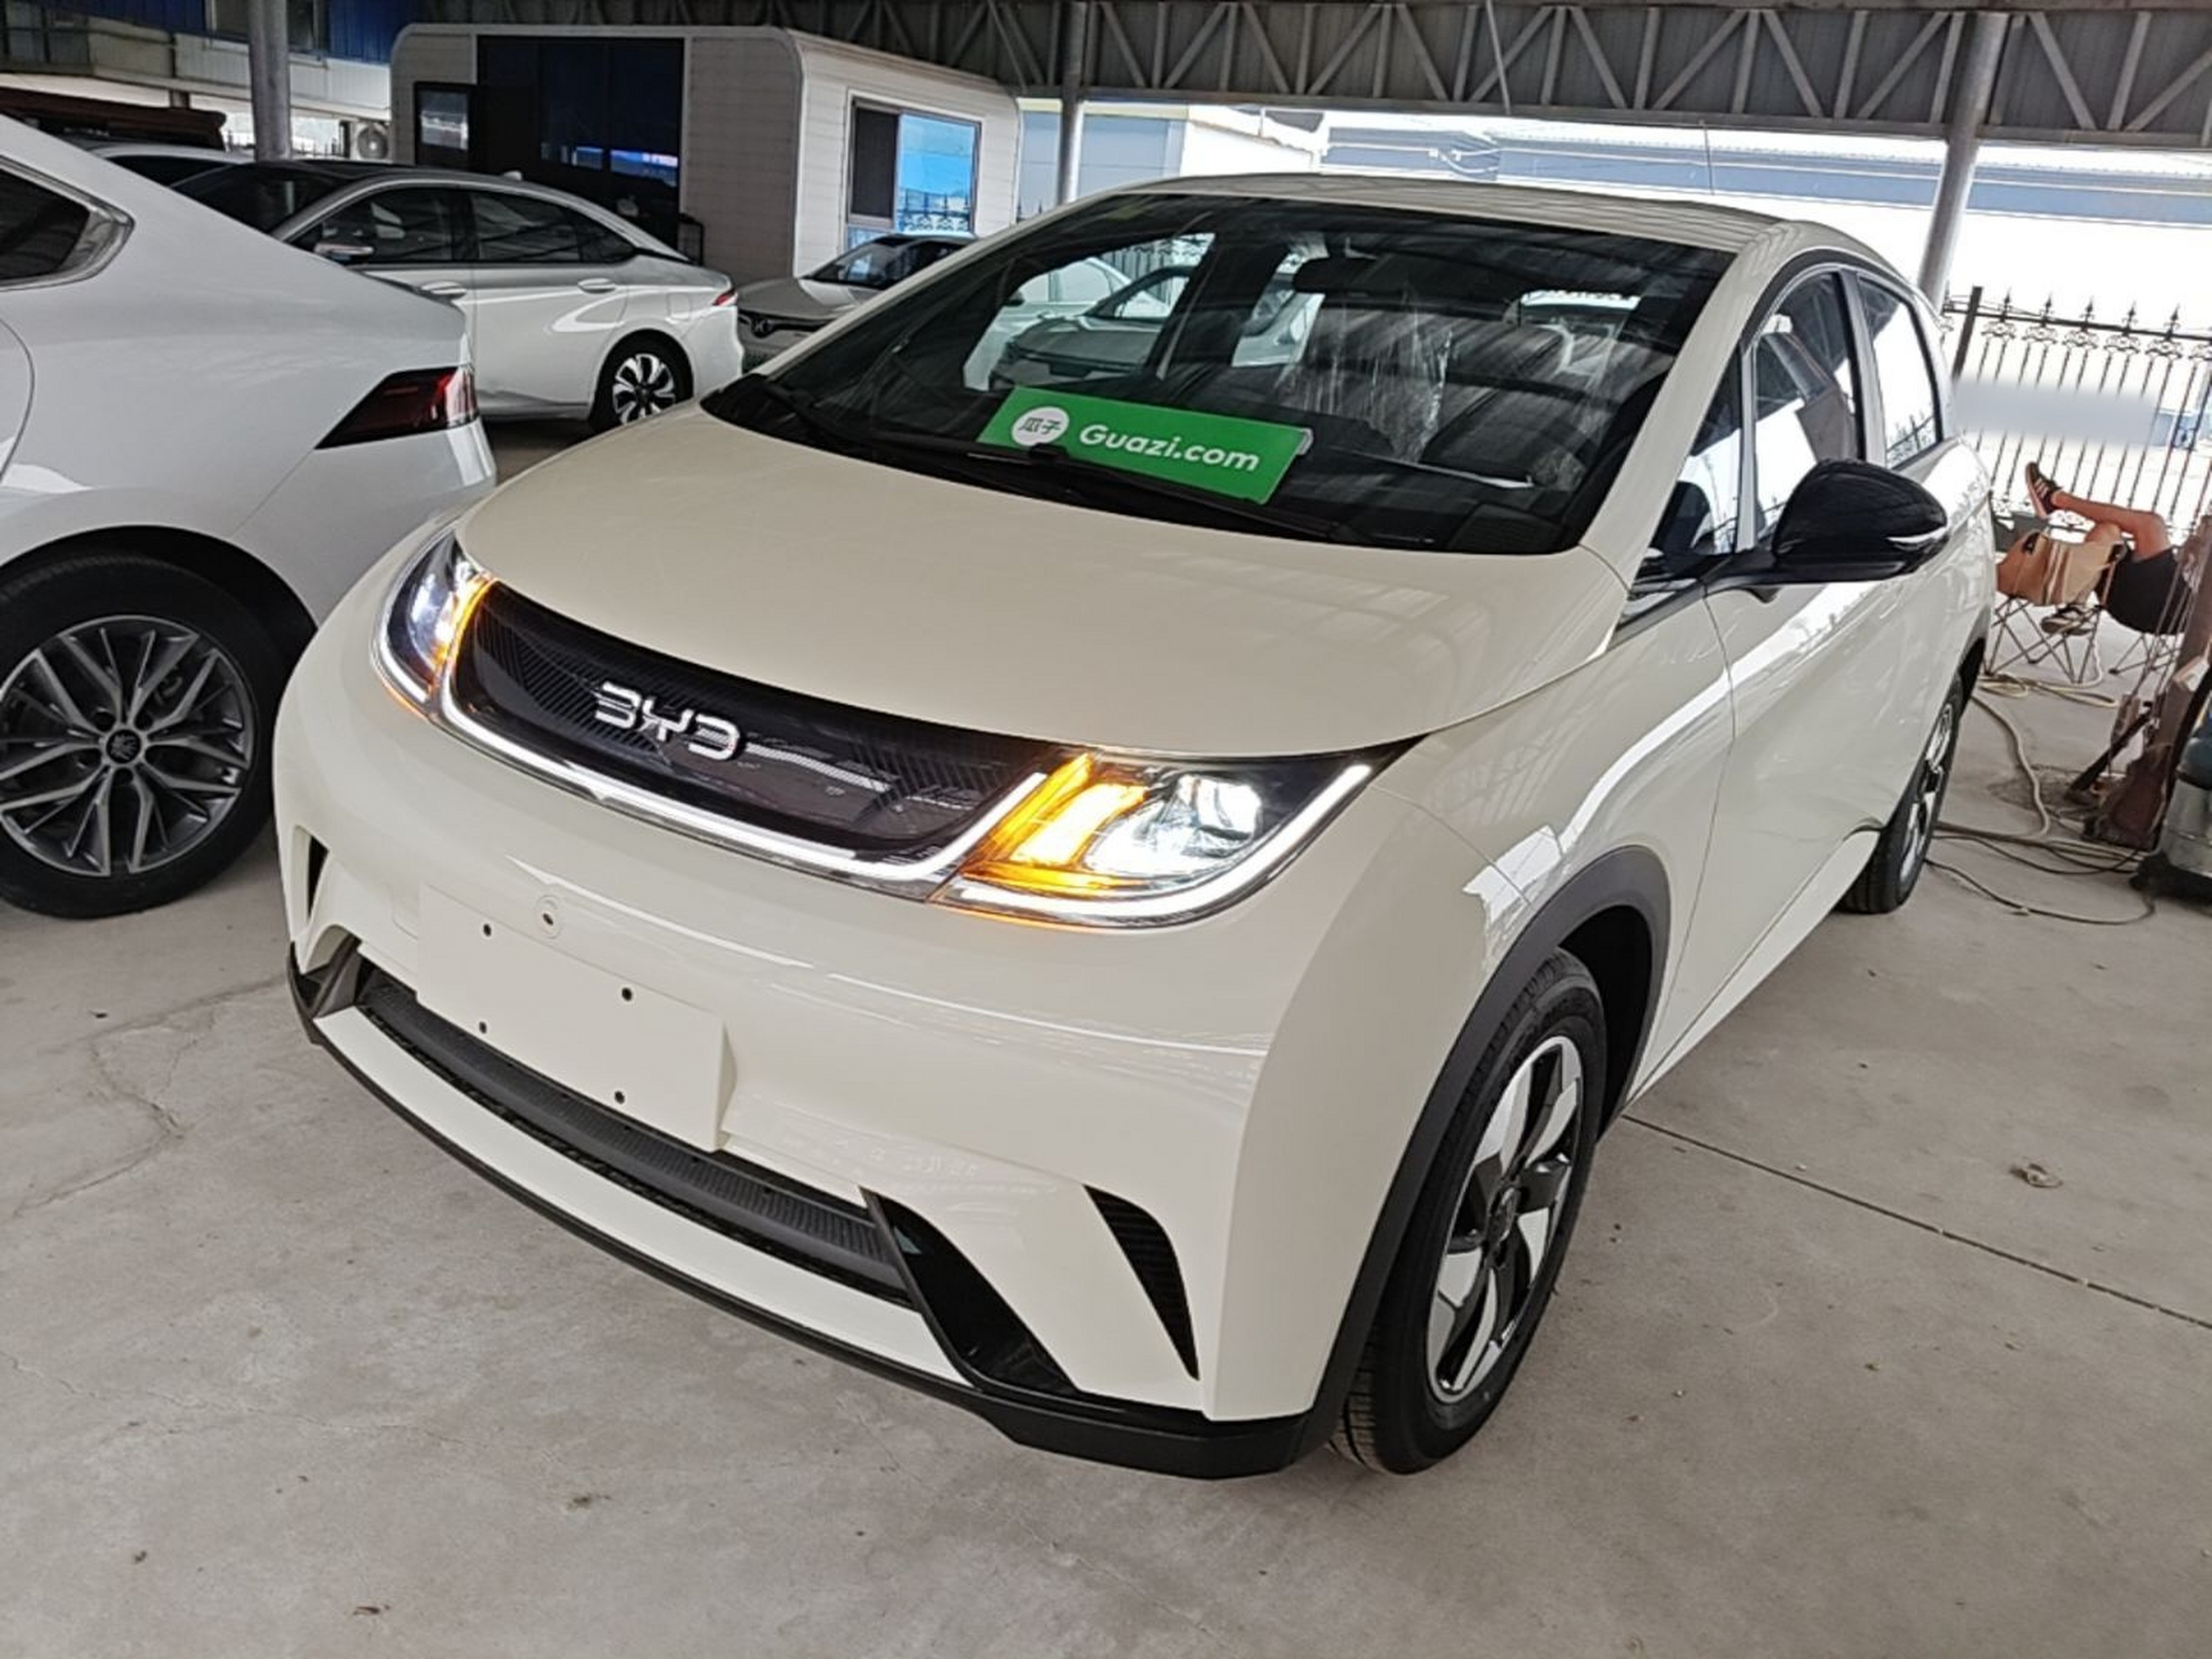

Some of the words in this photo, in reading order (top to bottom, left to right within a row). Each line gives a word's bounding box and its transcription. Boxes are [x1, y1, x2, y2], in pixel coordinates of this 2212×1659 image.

[1019, 416, 1062, 435] 瓜子
[1080, 425, 1259, 471] Guazi.com
[596, 681, 740, 760] BYD
